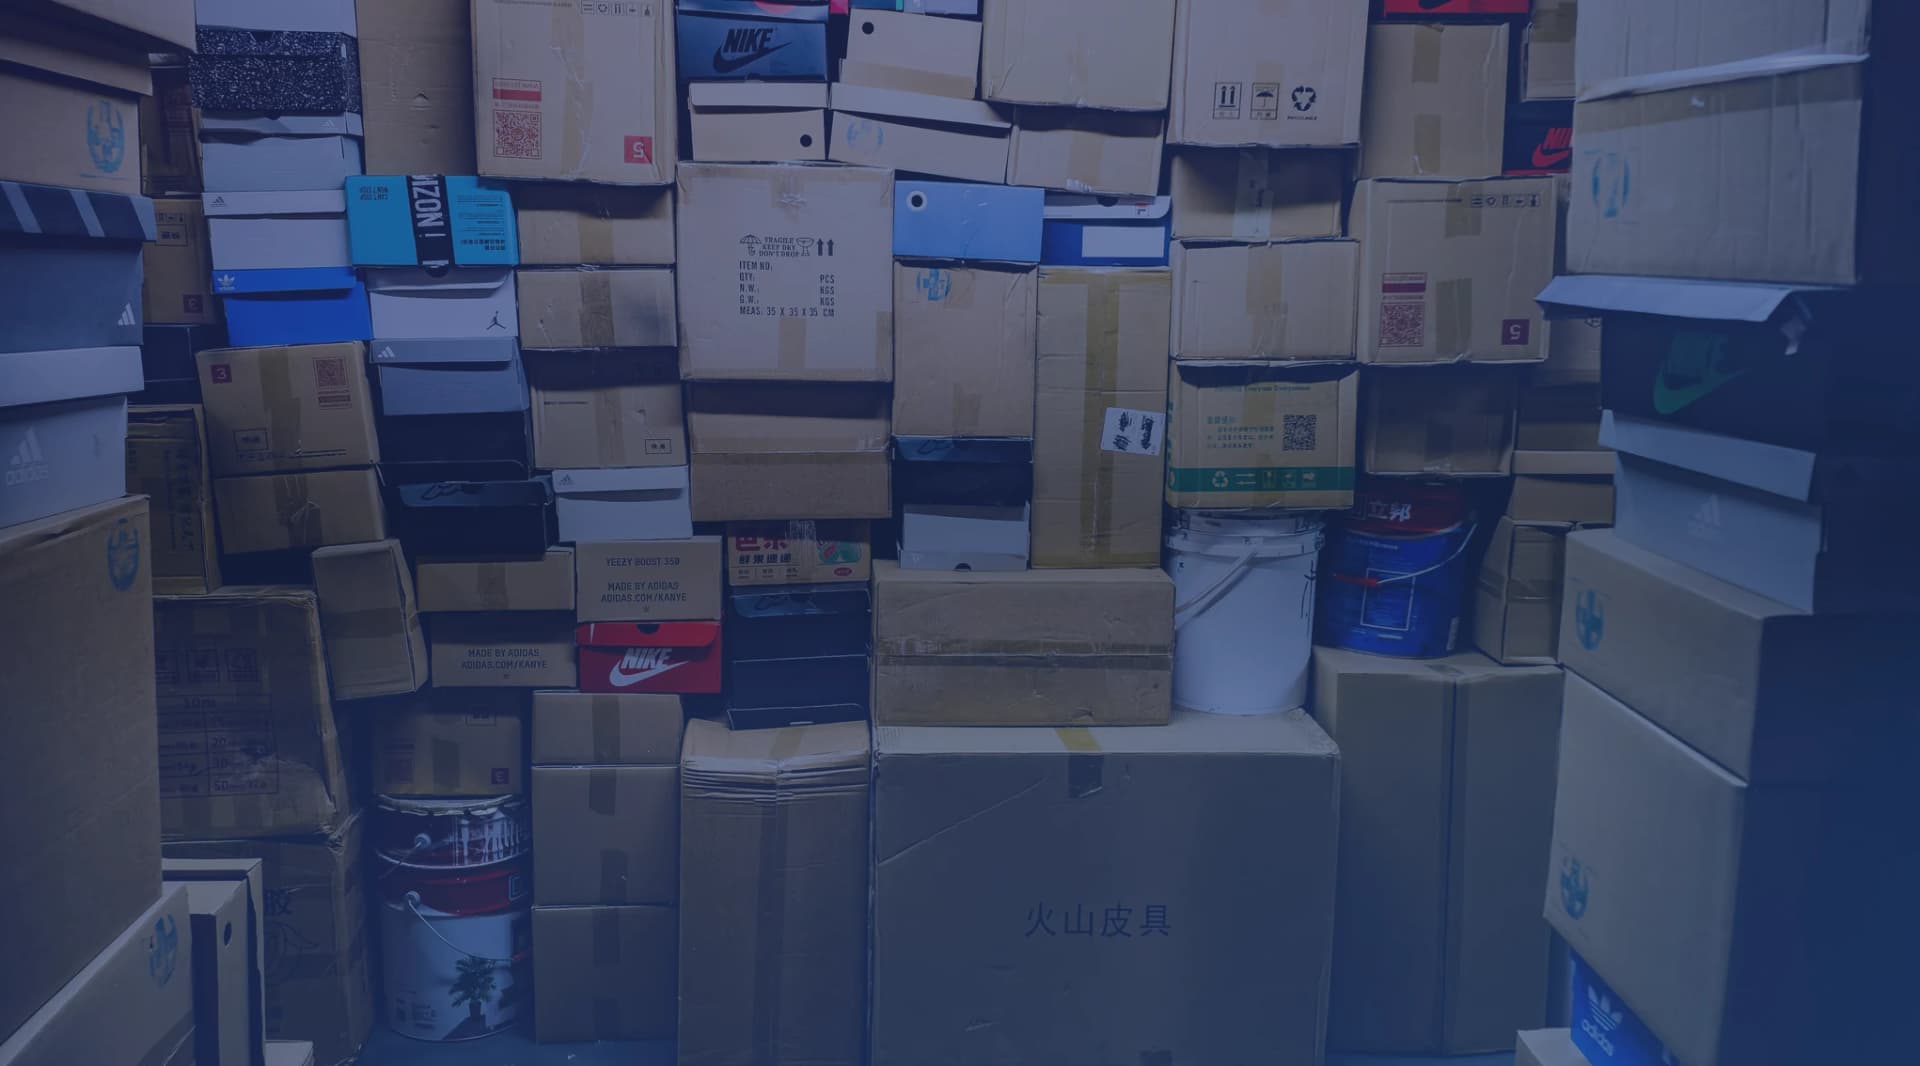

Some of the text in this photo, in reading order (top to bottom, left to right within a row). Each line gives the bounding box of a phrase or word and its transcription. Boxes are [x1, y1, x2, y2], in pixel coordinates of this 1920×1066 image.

[723, 27, 774, 53] NIKE
[764, 236, 795, 244] FRAGILE
[739, 260, 758, 271] ITEM
[819, 274, 835, 284] PCS
[819, 286, 835, 295] KGS
[819, 297, 835, 306] KGS
[766, 307, 776, 316] 35
[789, 307, 799, 317] 35
[809, 307, 819, 317] 35
[823, 308, 835, 317] CM
[606, 556, 680, 567] YEEZY BOOST 350
[607, 580, 680, 591] MADE BY ADIDAS
[600, 592, 688, 603] ADIDAS.COM/KANYE
[467, 647, 540, 657] MADE BY ADIDAS
[620, 648, 673, 670] NIKE
[462, 660, 548, 670] ADIDAS.COM/KANYE
[1024, 899, 1172, 939] 火山皮具
